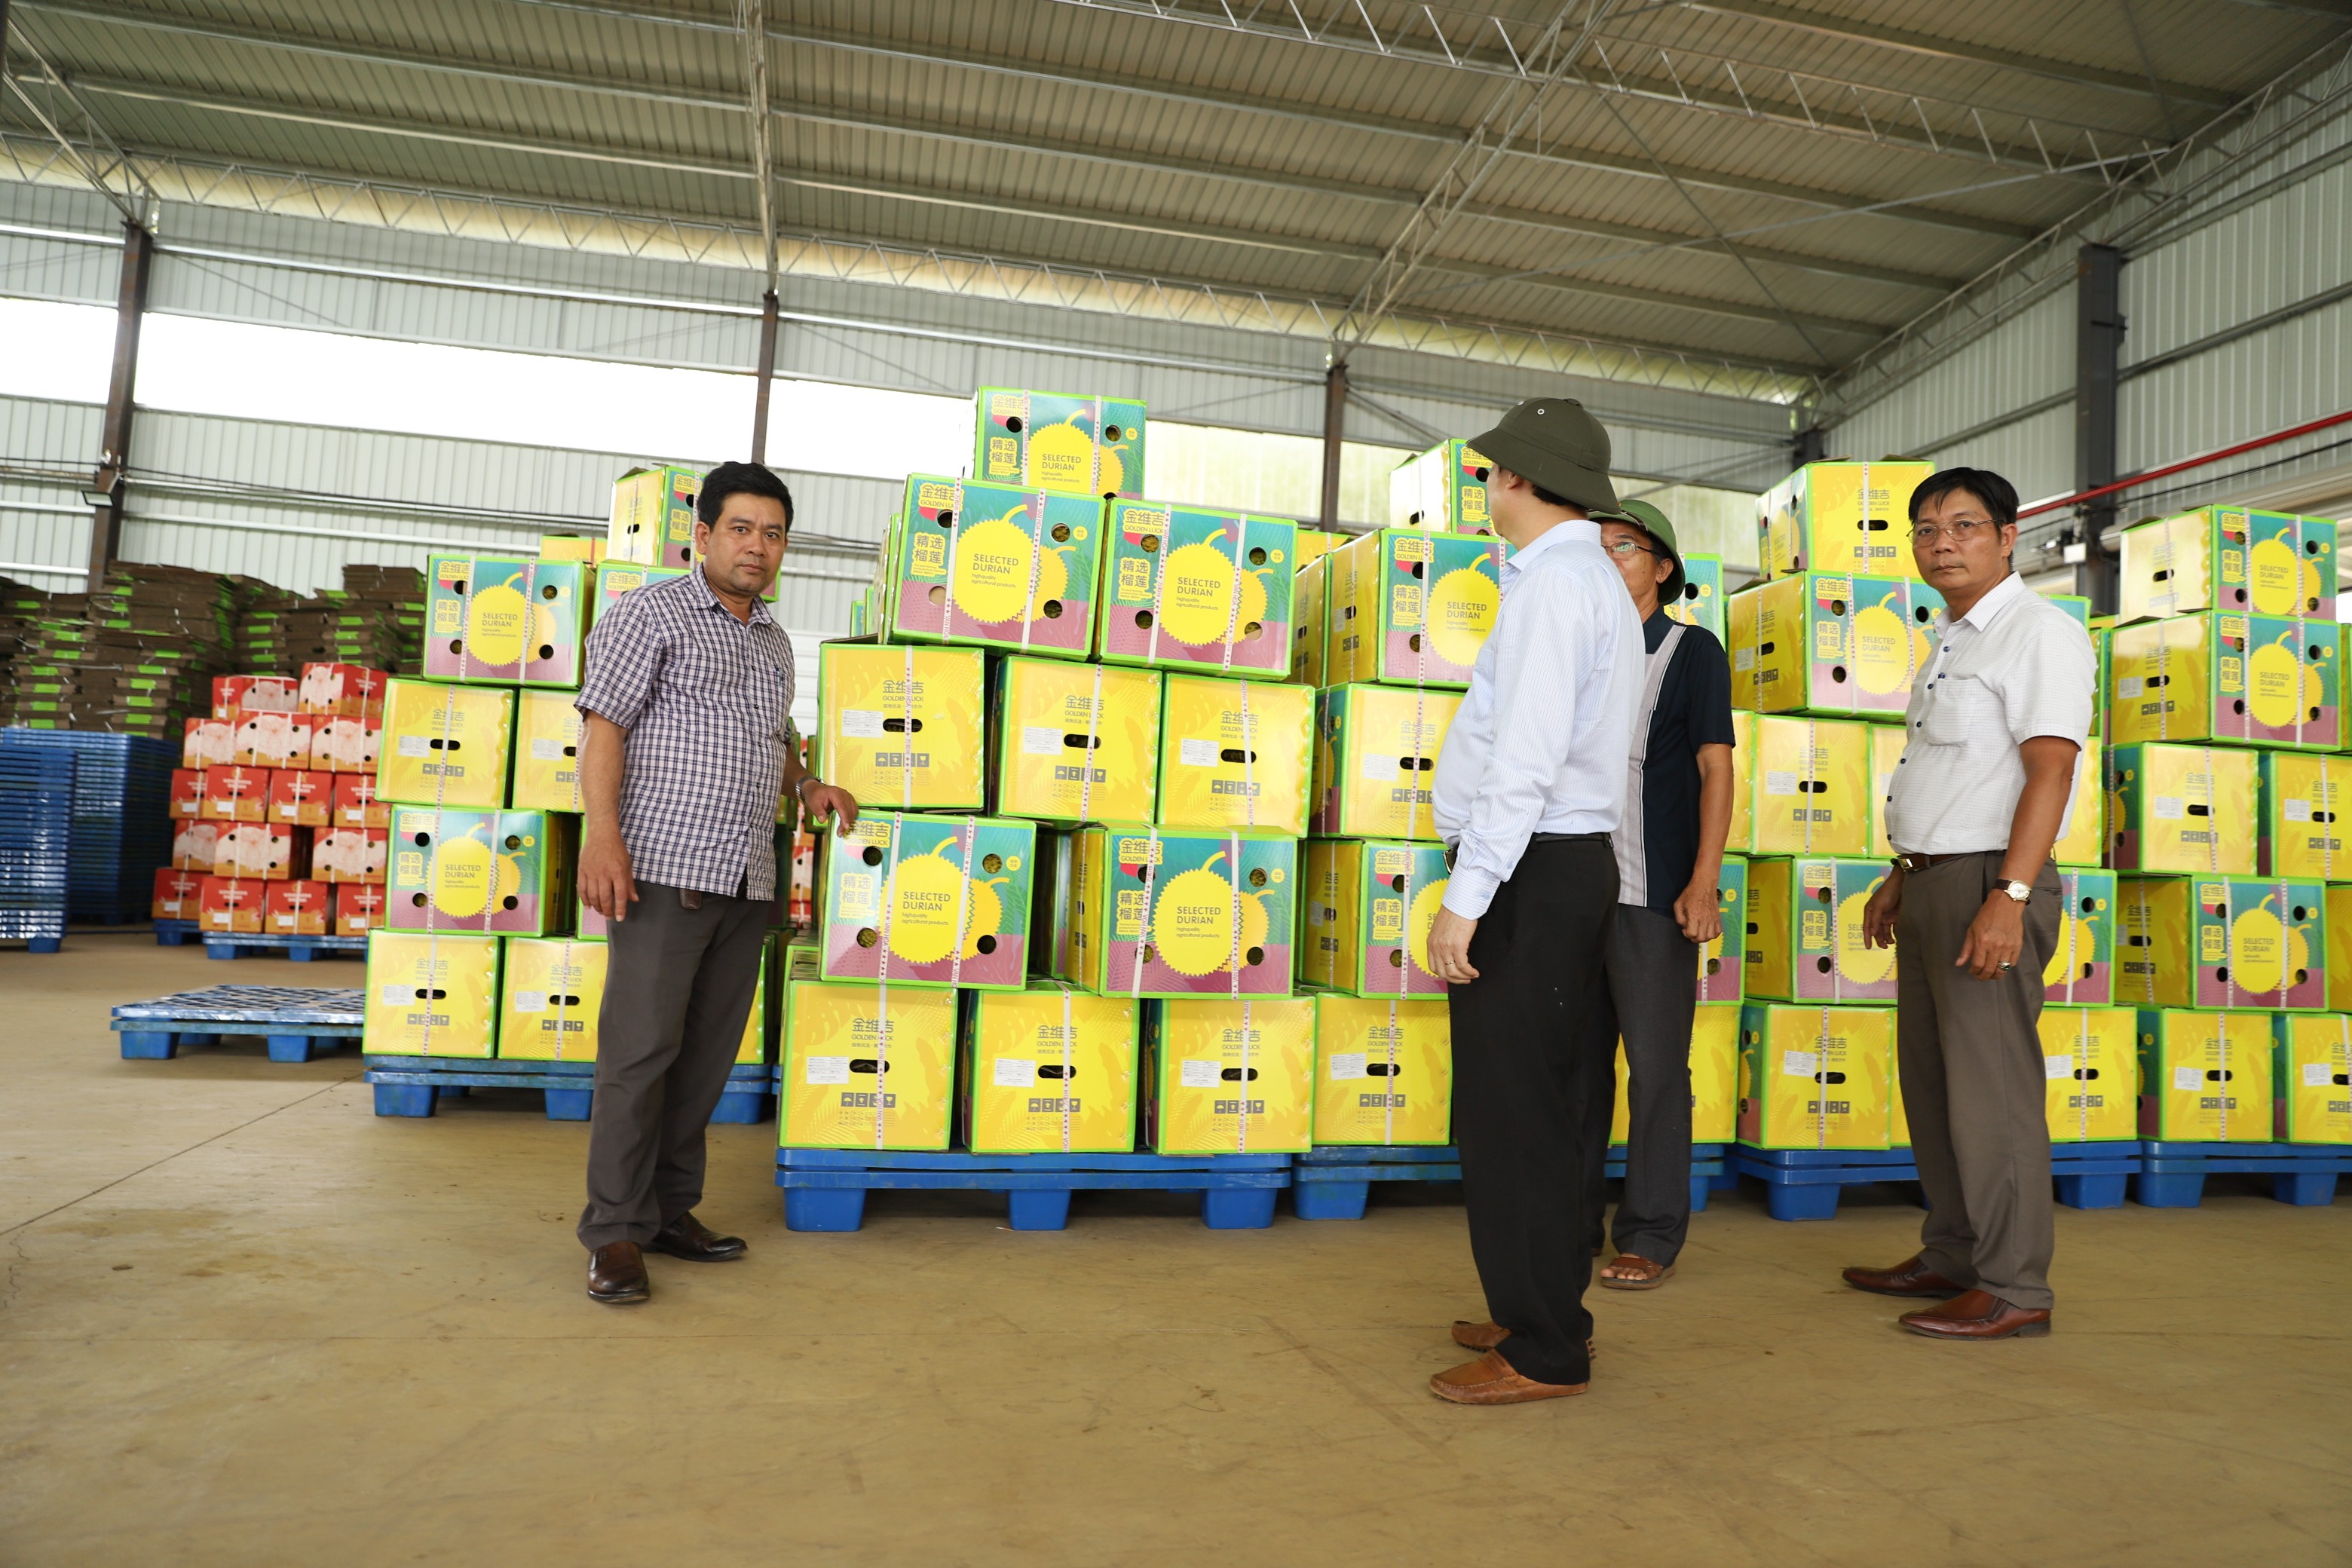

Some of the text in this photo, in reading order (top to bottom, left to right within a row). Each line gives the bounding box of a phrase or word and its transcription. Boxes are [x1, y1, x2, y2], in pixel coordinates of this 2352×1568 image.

[992, 439, 1015, 452] 精选
[991, 452, 1015, 464] 榴莲
[1043, 454, 1082, 464] SELECTED
[1042, 462, 1075, 471] DURIAN
[1463, 488, 1484, 499] 精选
[1463, 501, 1484, 511] 榴莲
[1125, 510, 1164, 525] 金维吉
[917, 534, 943, 550] 精选
[914, 550, 942, 564] 榴莲
[974, 554, 1018, 566] SELECTED
[972, 563, 1010, 574] DURIAN
[1122, 559, 1148, 574] 精选
[2260, 565, 2289, 574] SELECTED
[608, 574, 639, 585] 金维吉
[1122, 574, 1147, 588] 榴莲
[1178, 577, 1220, 589] SELECTED
[1177, 586, 1213, 596] DURIAN
[1818, 580, 1847, 593] 金维吉
[1395, 588, 1419, 600] 精选
[1395, 601, 1419, 613] 榴莲
[1447, 602, 1487, 611] SELECTED
[482, 612, 518, 620] SELECTED
[1447, 611, 1480, 619] DURIAN
[1819, 623, 1839, 635] 精选
[1819, 635, 1839, 648] 榴莲
[1863, 636, 1895, 645] SELECTED
[2260, 672, 2289, 680] SELECTED
[883, 679, 924, 694] 金维吉
[844, 876, 871, 890] 精选
[843, 891, 870, 905] 榴莲
[903, 891, 951, 902] SELECTED
[1120, 893, 1144, 906] 精选
[902, 901, 942, 911] DURIAN
[1177, 906, 1221, 916] SELECTED
[1376, 901, 1400, 913] 精选
[1119, 908, 1143, 921] 榴莲
[1177, 915, 1214, 924] DURIAN
[1376, 914, 1400, 927] 榴莲
[852, 1018, 894, 1033] 金维吉
